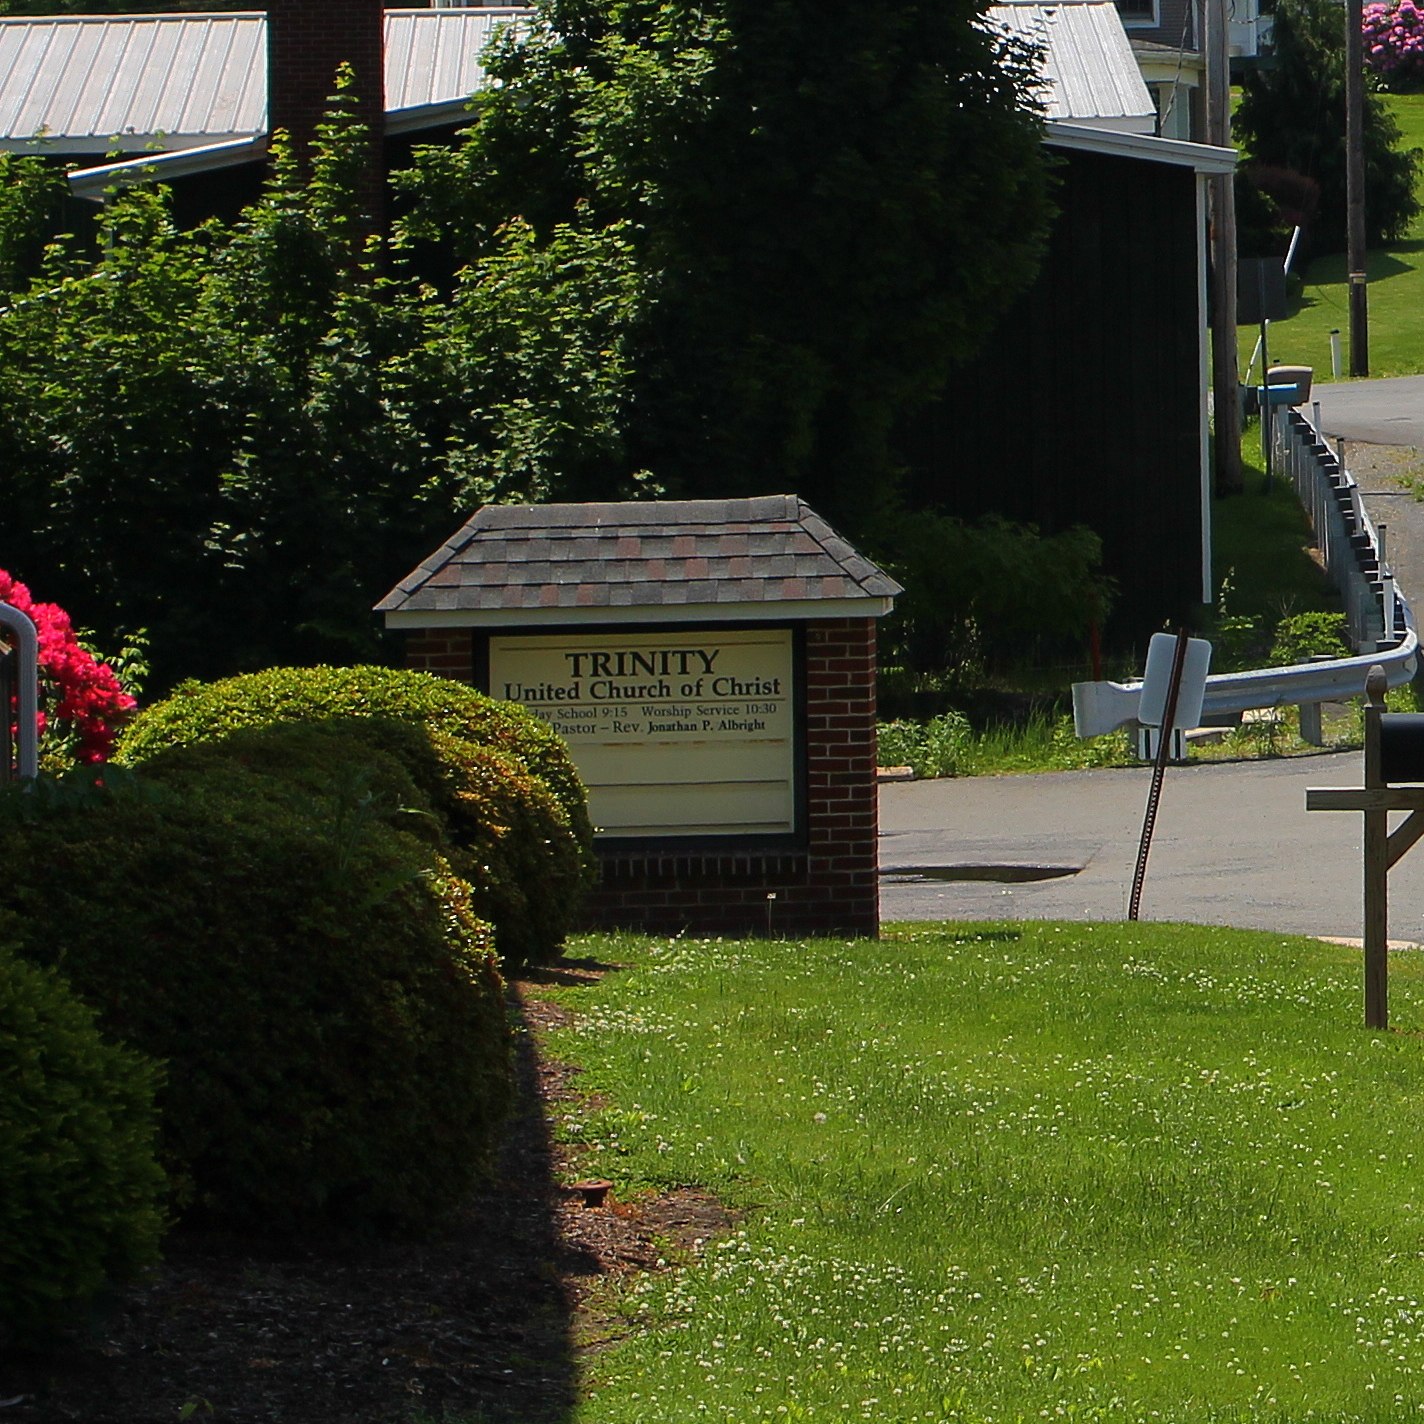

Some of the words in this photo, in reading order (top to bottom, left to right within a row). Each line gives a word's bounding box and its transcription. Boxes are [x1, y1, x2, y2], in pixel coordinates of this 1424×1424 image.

[565, 649, 720, 678] TRINITY
[504, 681, 581, 701] United
[589, 679, 671, 700] Church
[681, 678, 704, 697] of
[712, 677, 781, 696] Christ
[557, 707, 597, 719] School
[602, 706, 628, 718] 9:15
[642, 705, 692, 719] Worship
[696, 703, 740, 716] Service
[745, 702, 777, 715] 10:30
[553, 722, 597, 734] Pastor
[613, 720, 644, 734] Rev.
[648, 720, 697, 735] Jonathan
[702, 719, 714, 731] P.
[718, 718, 766, 732] Albright
